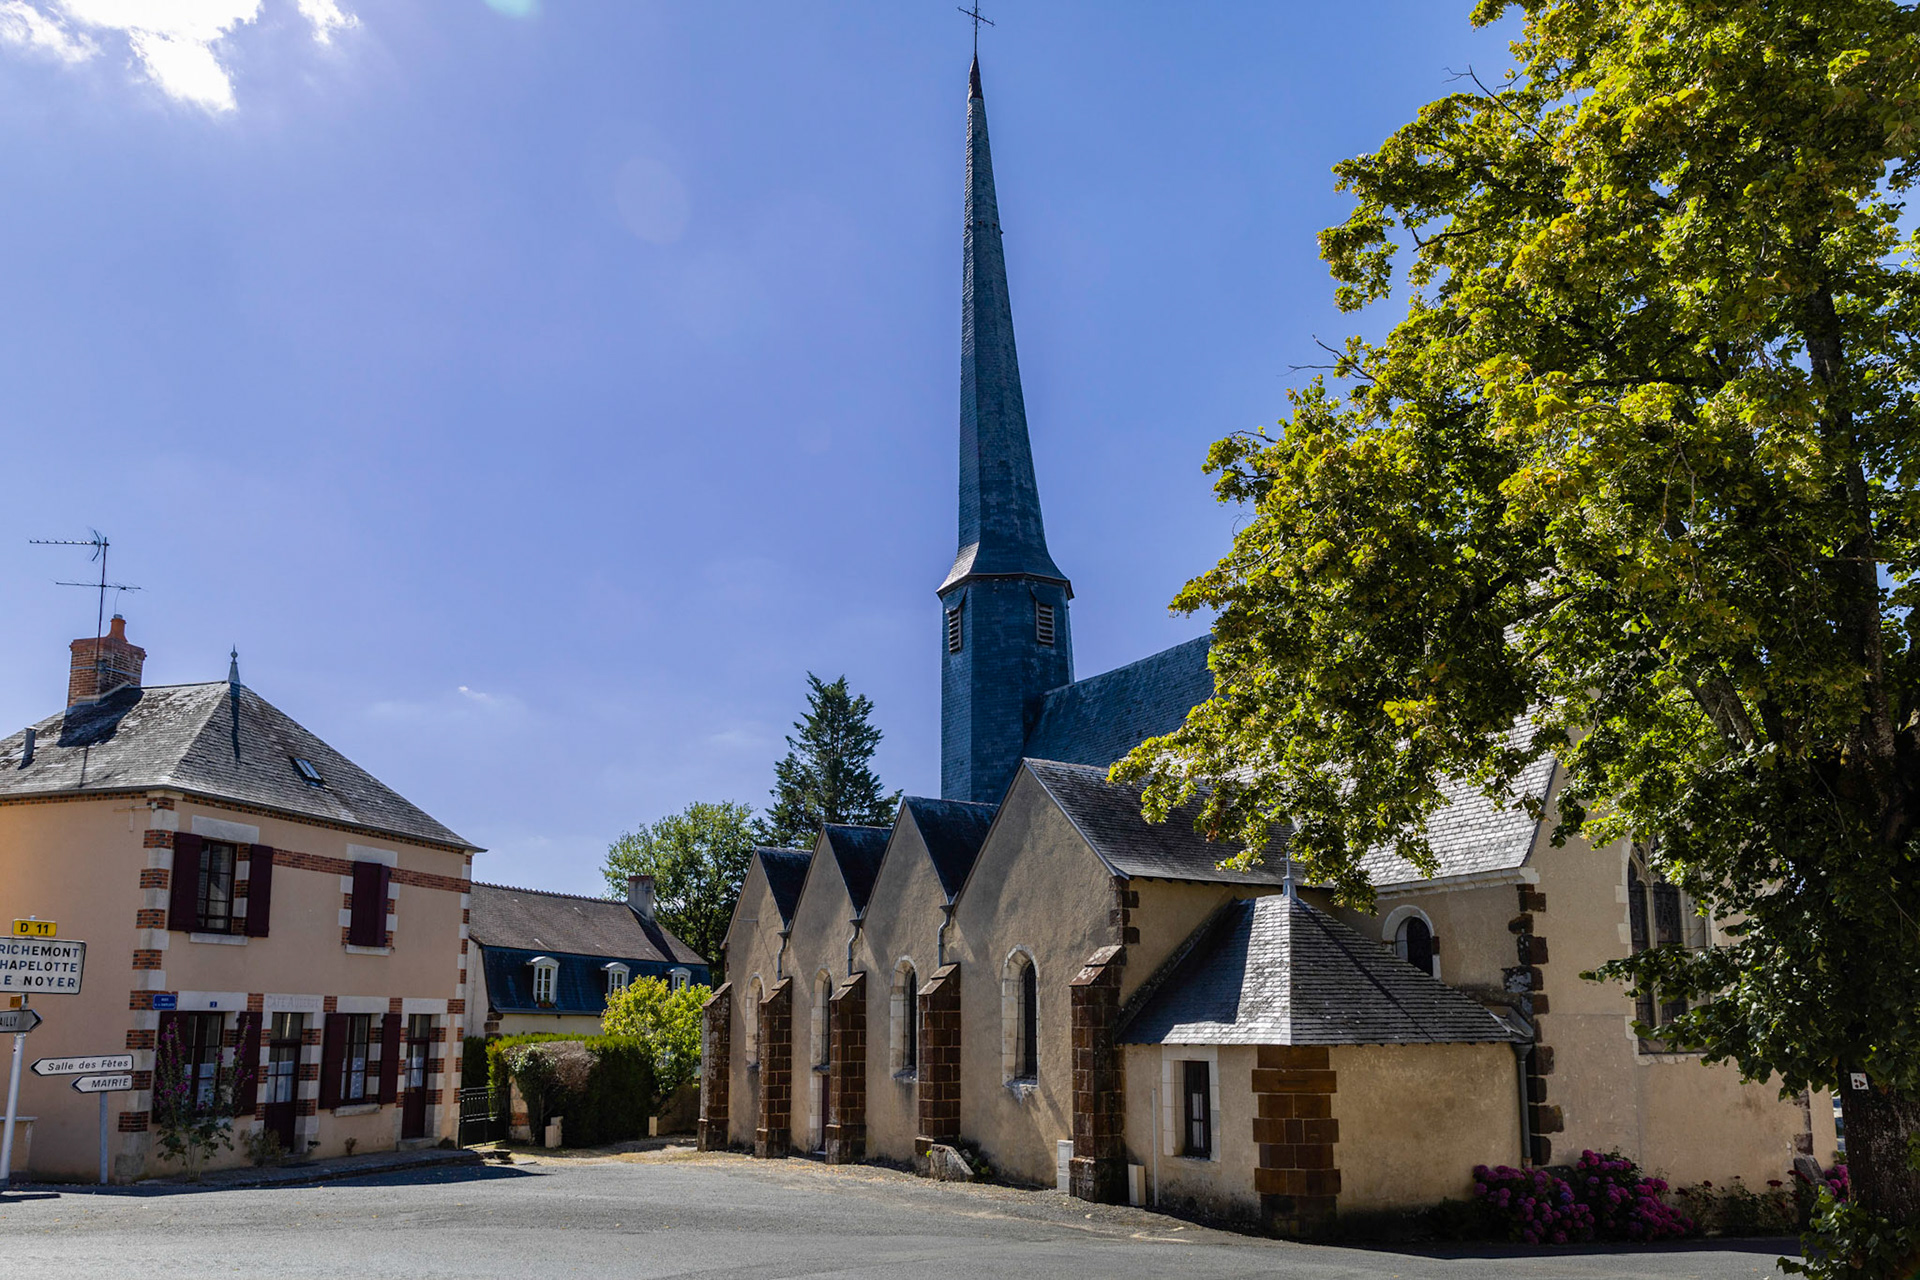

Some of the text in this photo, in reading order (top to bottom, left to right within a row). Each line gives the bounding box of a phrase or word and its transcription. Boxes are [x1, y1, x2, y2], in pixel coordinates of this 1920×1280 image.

[20, 923, 49, 934] D 11
[0, 975, 76, 988] E NOYER
[47, 1062, 74, 1072] Salle
[78, 1061, 97, 1070] des
[91, 1078, 129, 1089] MAIRIE
